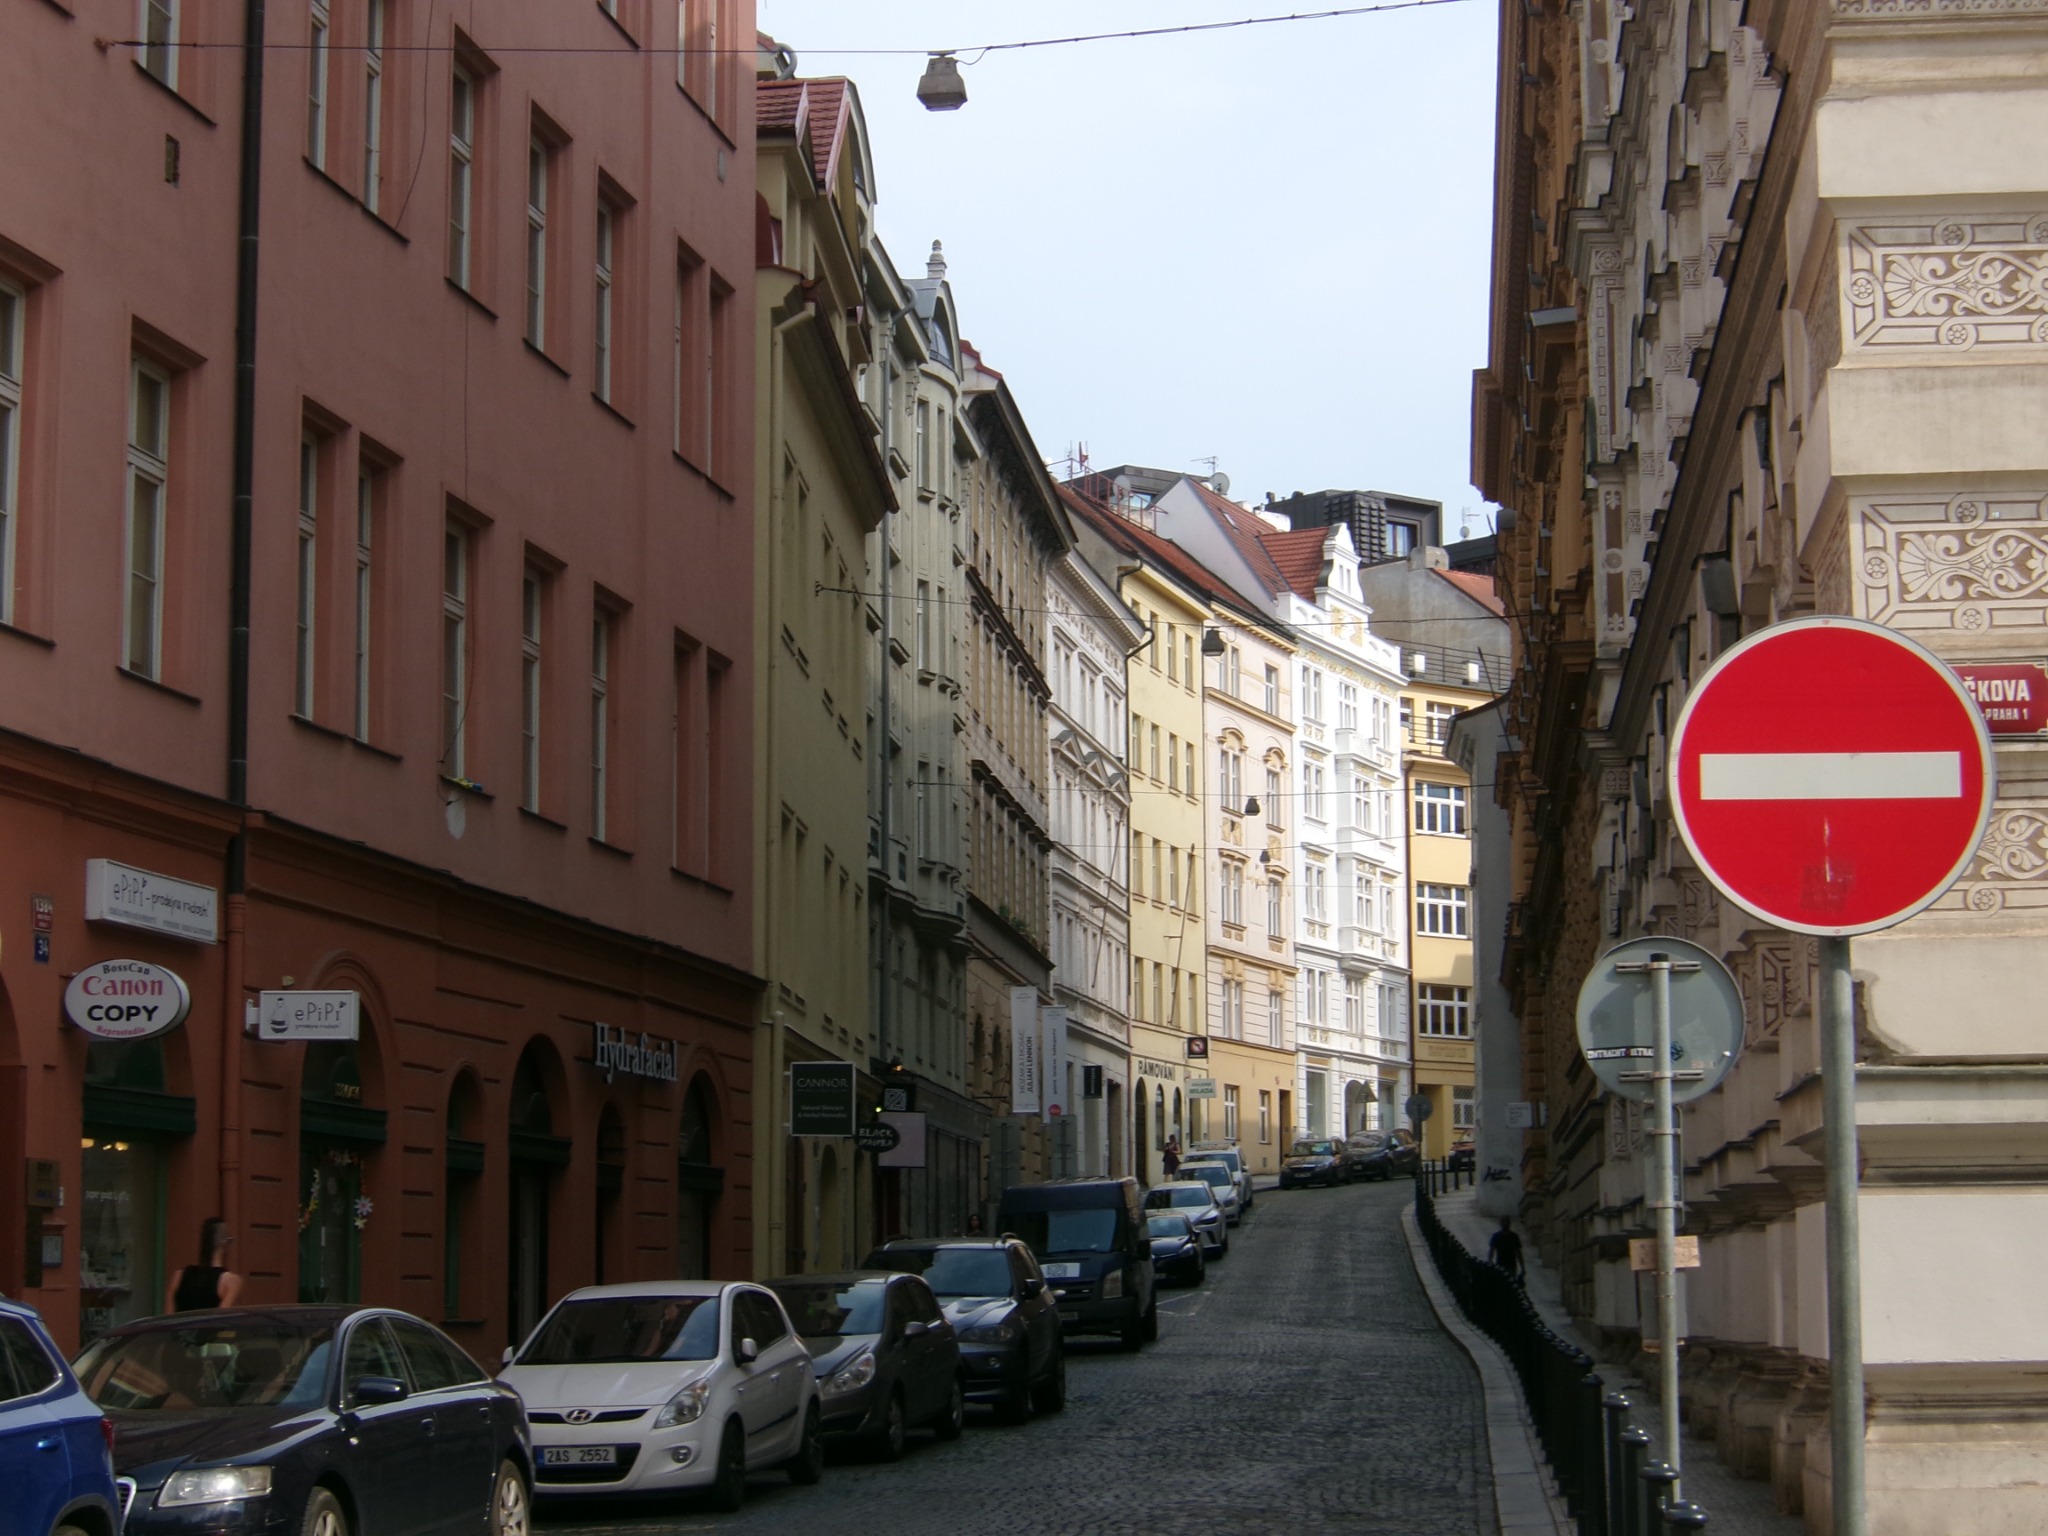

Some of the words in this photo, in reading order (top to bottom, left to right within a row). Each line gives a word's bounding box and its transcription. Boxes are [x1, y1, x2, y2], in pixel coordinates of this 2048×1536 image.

[2022, 708, 2029, 720] 1
[38, 939, 49, 955] 34
[102, 963, 150, 975] BossCan
[82, 976, 164, 996] Canon
[87, 1005, 159, 1022] COPY
[595, 1021, 678, 1084] Hydrafacial
[796, 1078, 849, 1088] CANNOR
[859, 1128, 893, 1137] BLACK
[547, 1449, 570, 1463] 2AS
[579, 1448, 610, 1462] 2552
